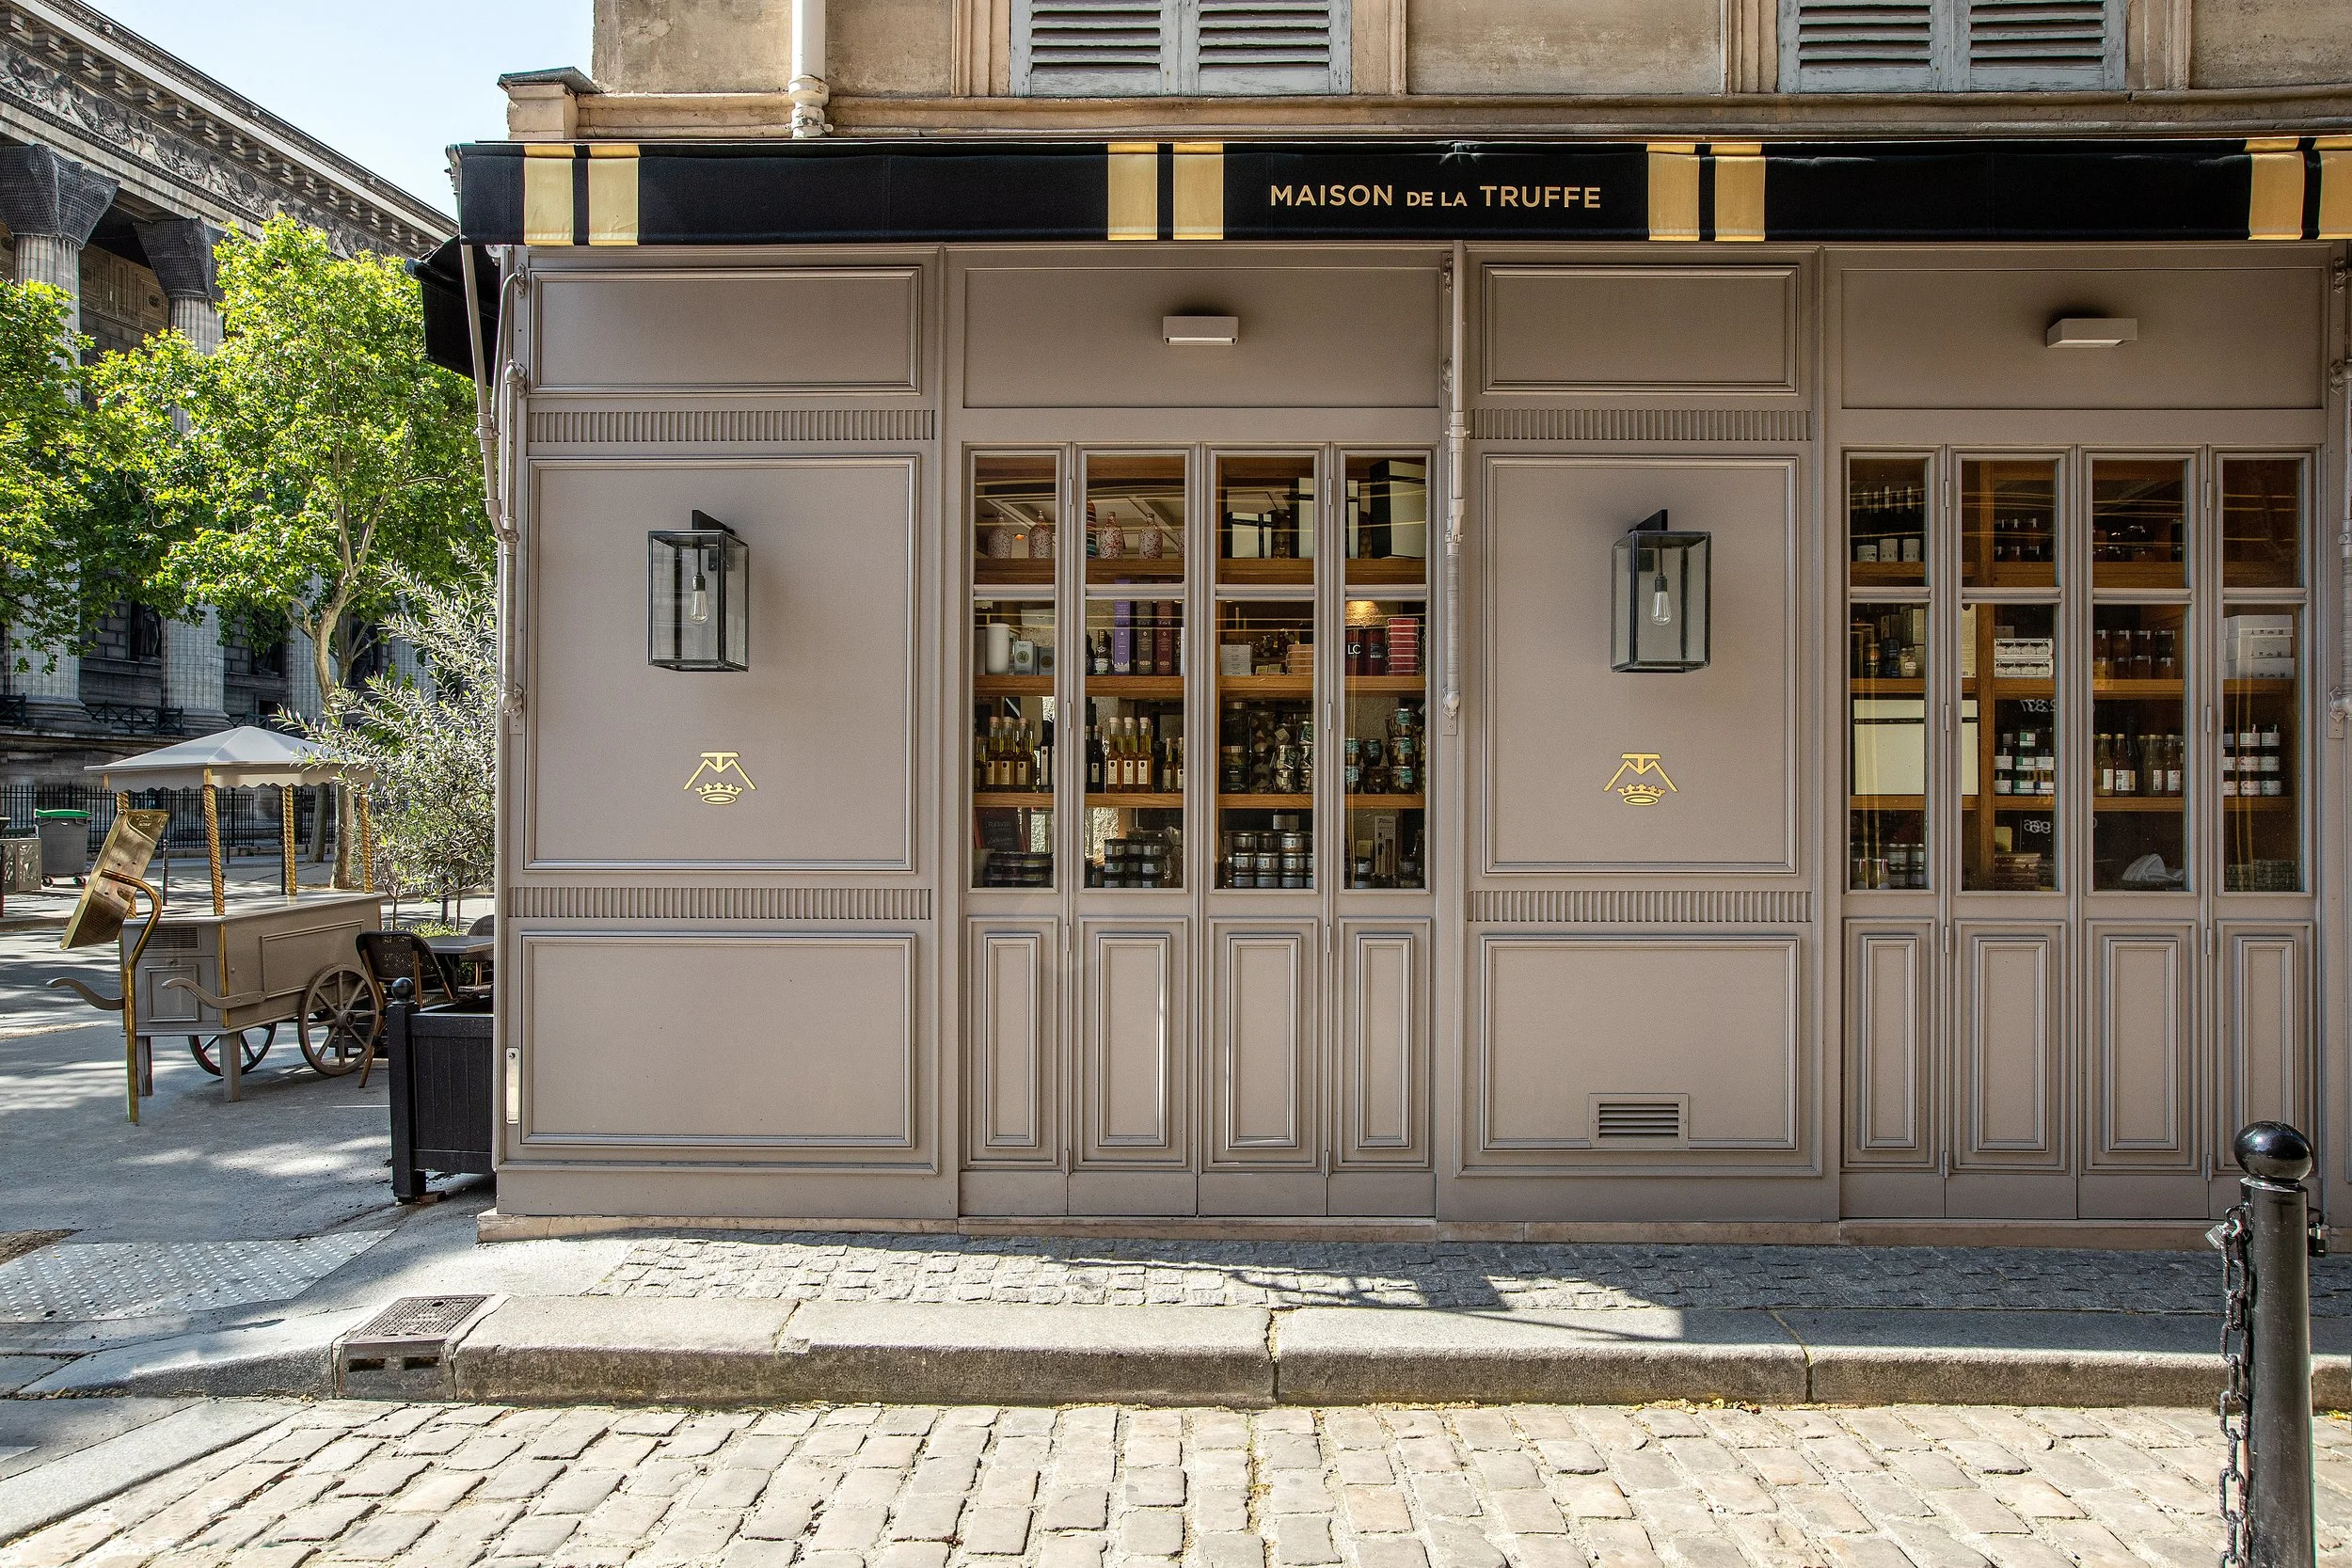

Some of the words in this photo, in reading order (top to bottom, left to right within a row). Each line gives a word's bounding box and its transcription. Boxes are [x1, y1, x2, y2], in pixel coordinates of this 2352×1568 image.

[1271, 185, 1392, 206] MAISON
[1406, 192, 1433, 207] DE
[1441, 192, 1468, 207] LA
[1480, 185, 1600, 208] TRUFFE
[1347, 644, 1361, 655] LC
